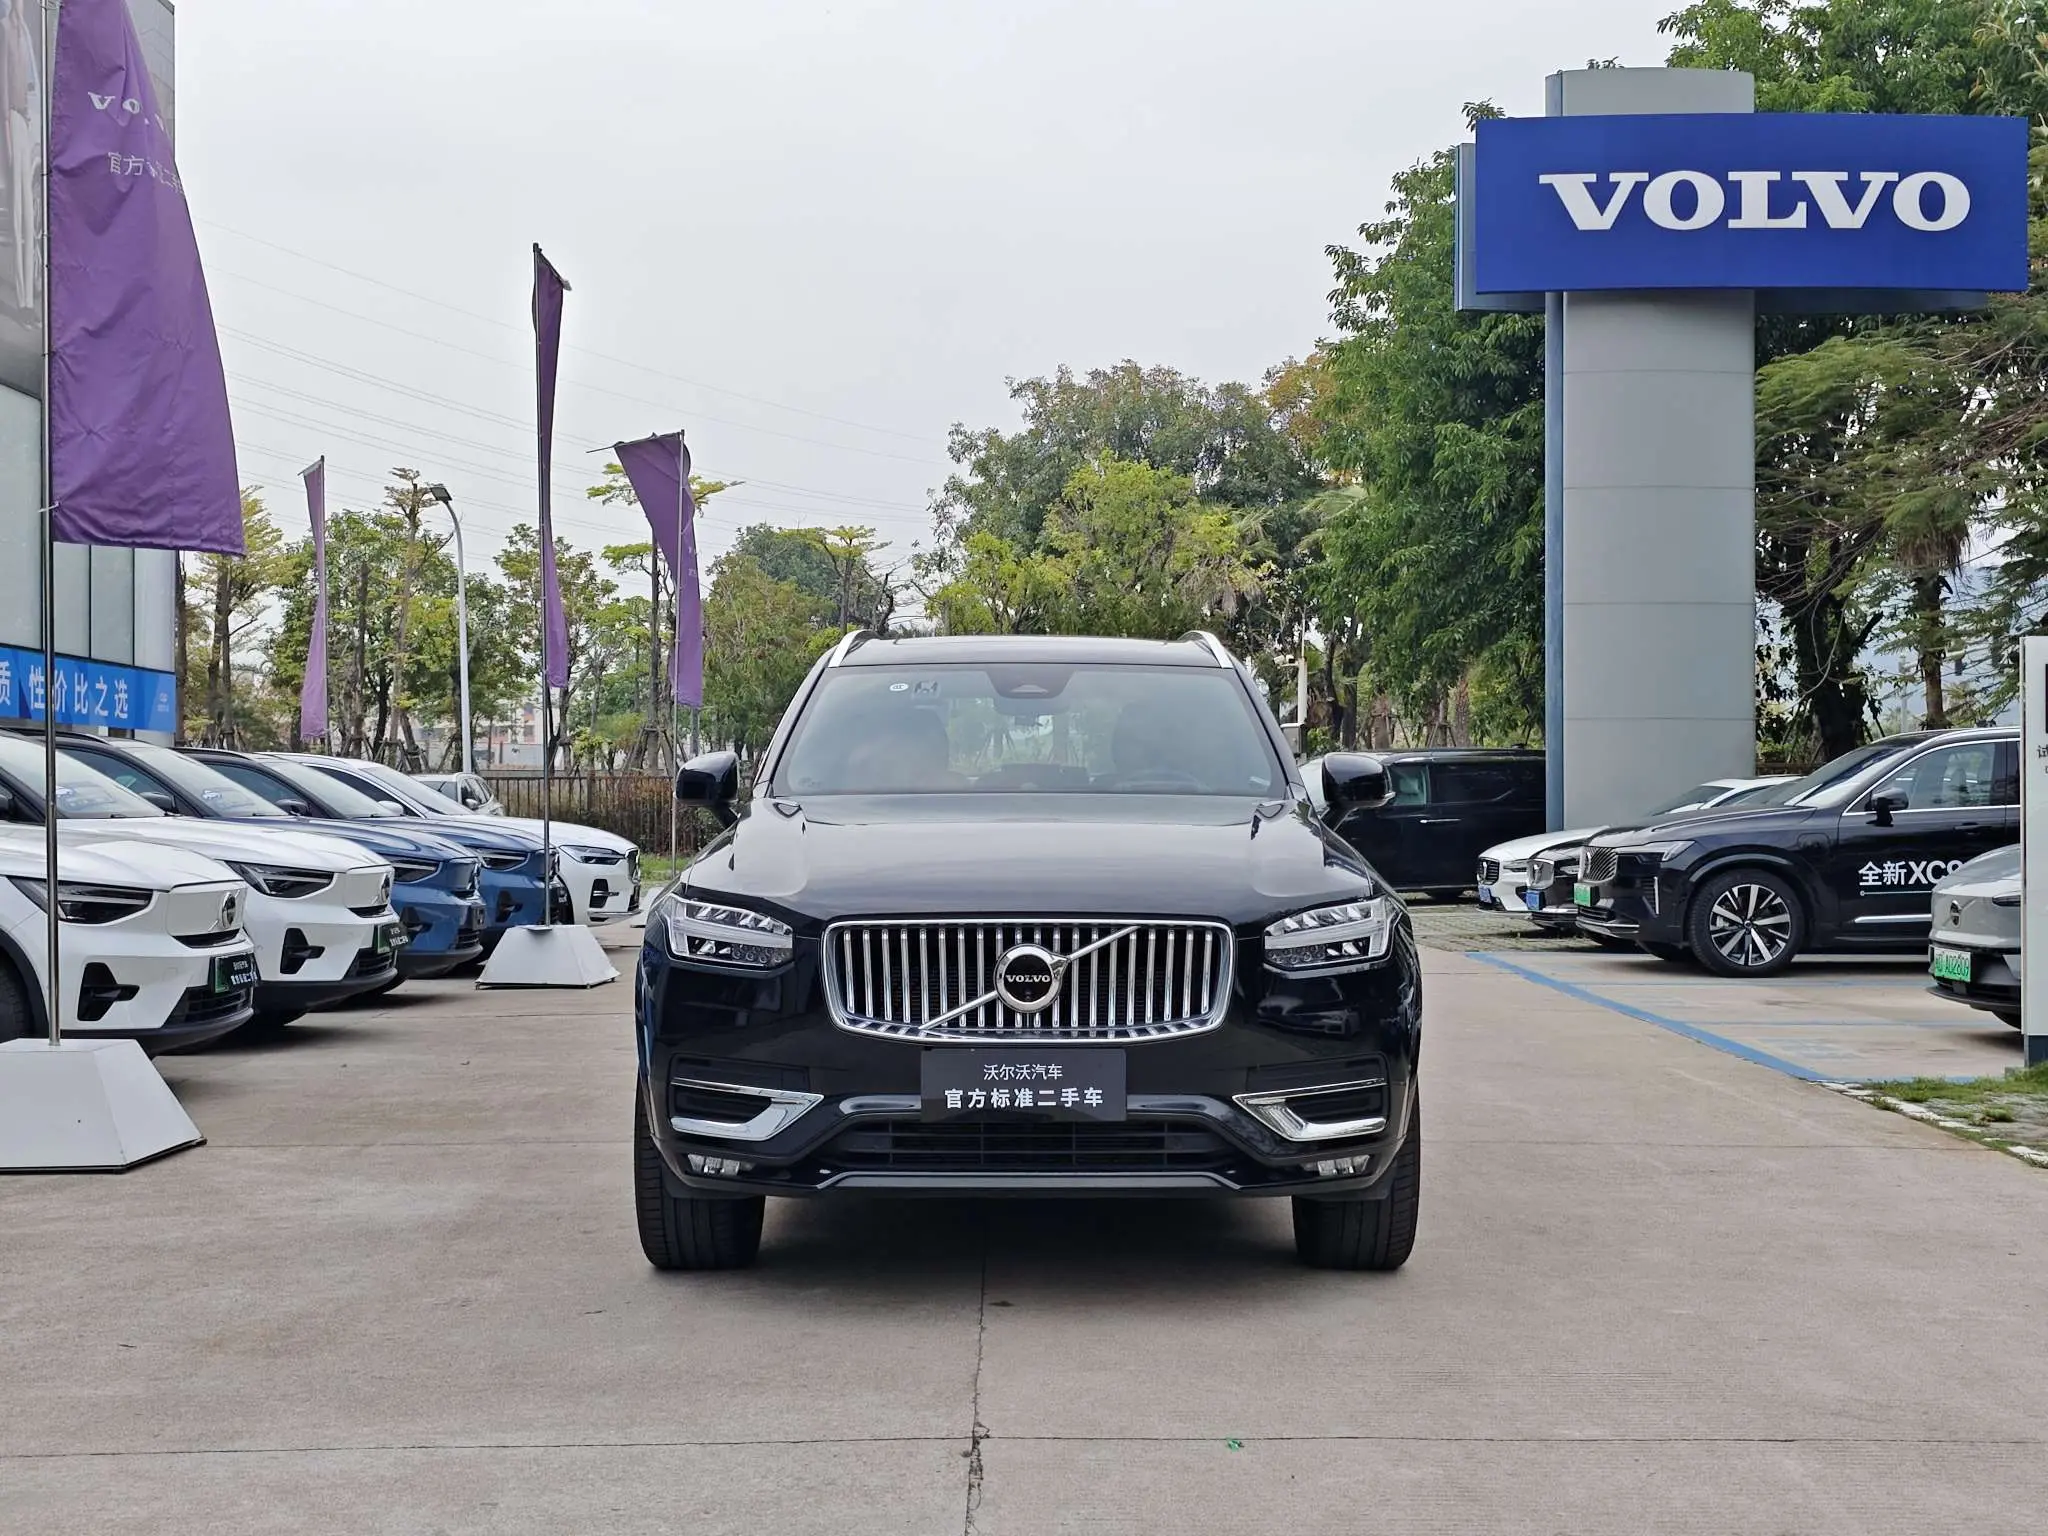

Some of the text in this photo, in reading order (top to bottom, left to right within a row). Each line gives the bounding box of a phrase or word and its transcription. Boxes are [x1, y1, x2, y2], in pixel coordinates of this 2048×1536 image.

[1538, 170, 1971, 232] VOLVO
[28, 664, 129, 719] 性价比之选
[1005, 974, 1051, 983] VOLVO
[983, 1064, 1063, 1081] 沃尔沃汽车
[944, 1087, 1103, 1109] 官方标准二手车
